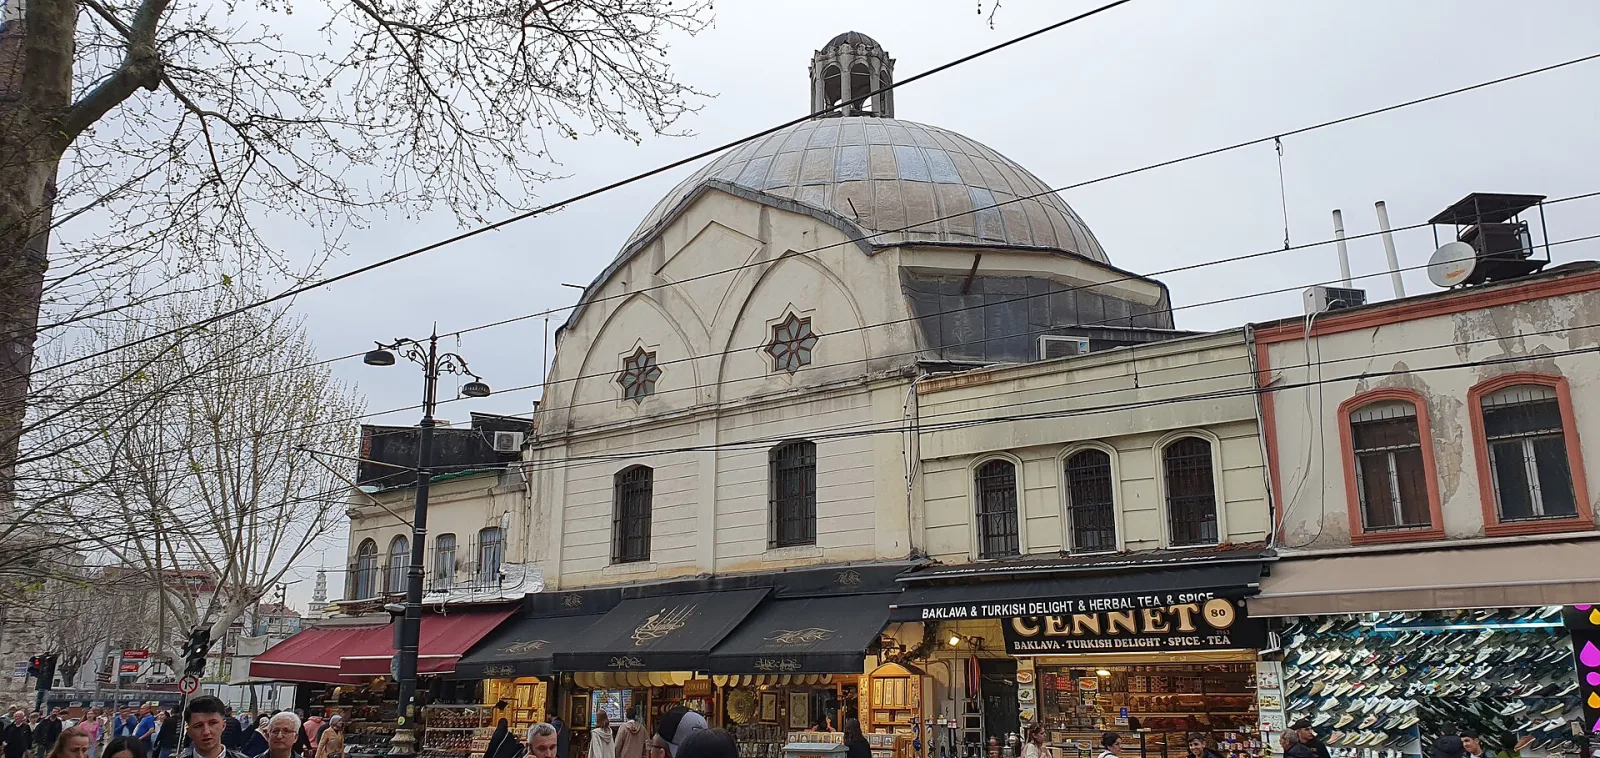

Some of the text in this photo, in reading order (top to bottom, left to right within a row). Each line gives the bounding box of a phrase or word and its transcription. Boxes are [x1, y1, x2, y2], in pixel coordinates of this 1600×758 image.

[922, 592, 1214, 619] BAKLAVA & TURKISH DELIGHT & HERBAL TEA & SPICE
[1012, 603, 1226, 637] CENNET 80
[1013, 640, 1060, 650] BAKLAVA
[1066, 639, 1112, 649] TURKISH
[1114, 637, 1160, 648] DELIGHT
[1168, 636, 1200, 647] SPICE
[1207, 635, 1231, 645] TEA
